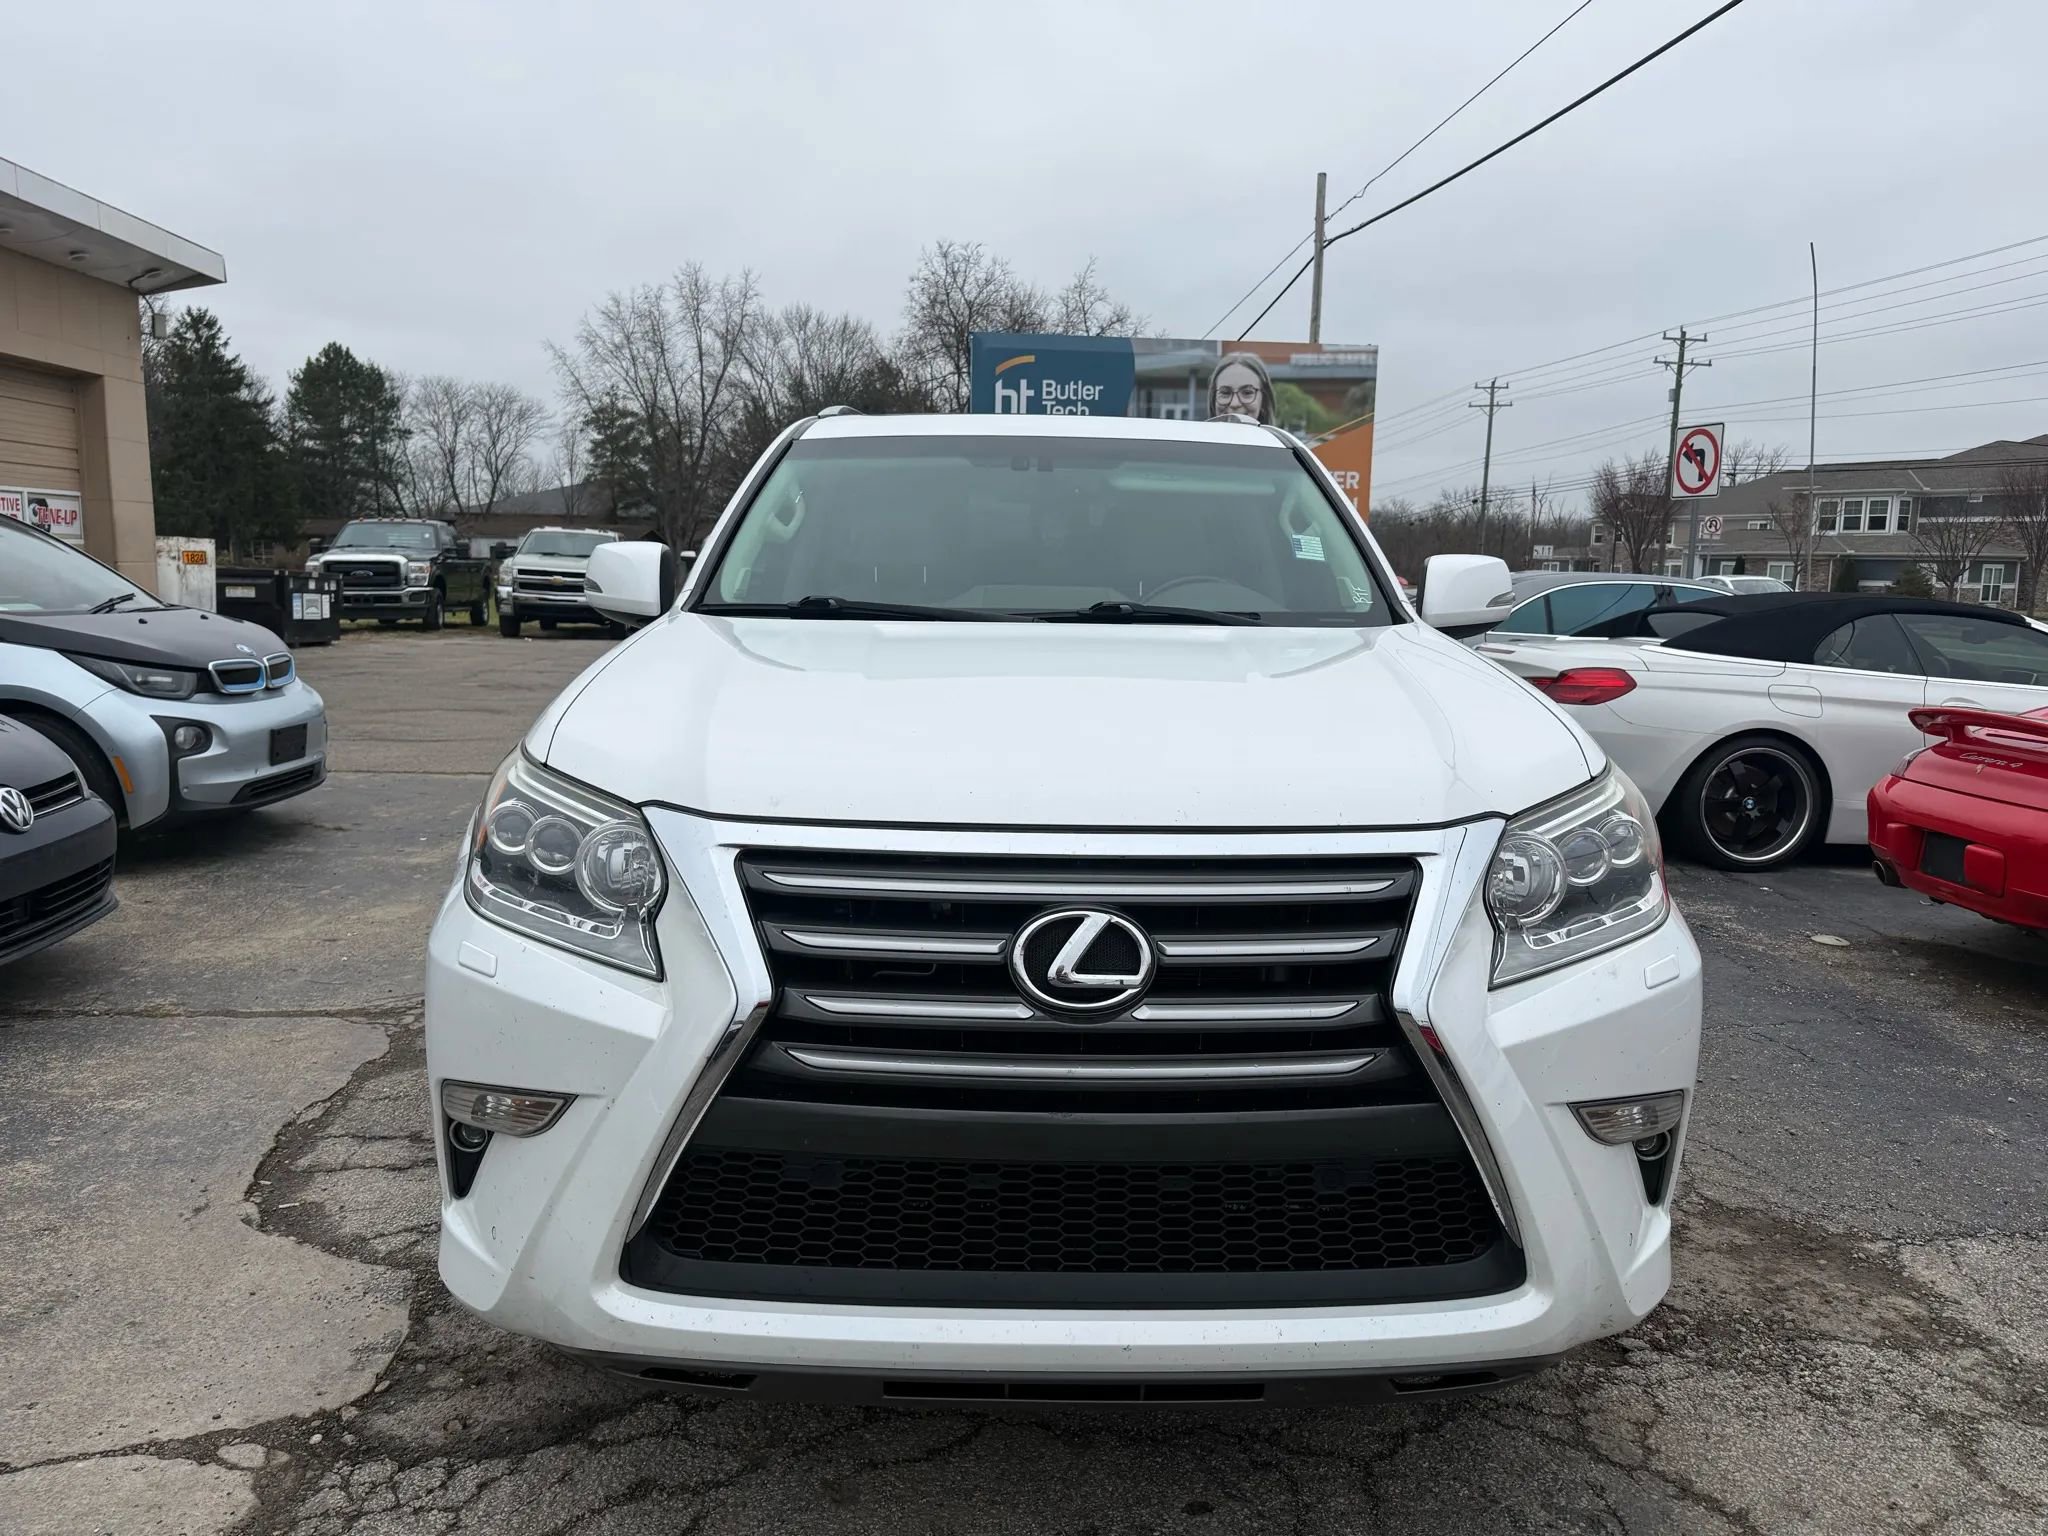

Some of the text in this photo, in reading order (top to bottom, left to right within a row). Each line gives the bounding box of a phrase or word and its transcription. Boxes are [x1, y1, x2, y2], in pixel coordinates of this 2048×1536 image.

[1041, 379, 1104, 401] Butler
[1041, 400, 1090, 416] Tech
[1329, 470, 1361, 490] ER
[36, 505, 78, 527] TUNE-UP
[185, 552, 205, 563] 1824
